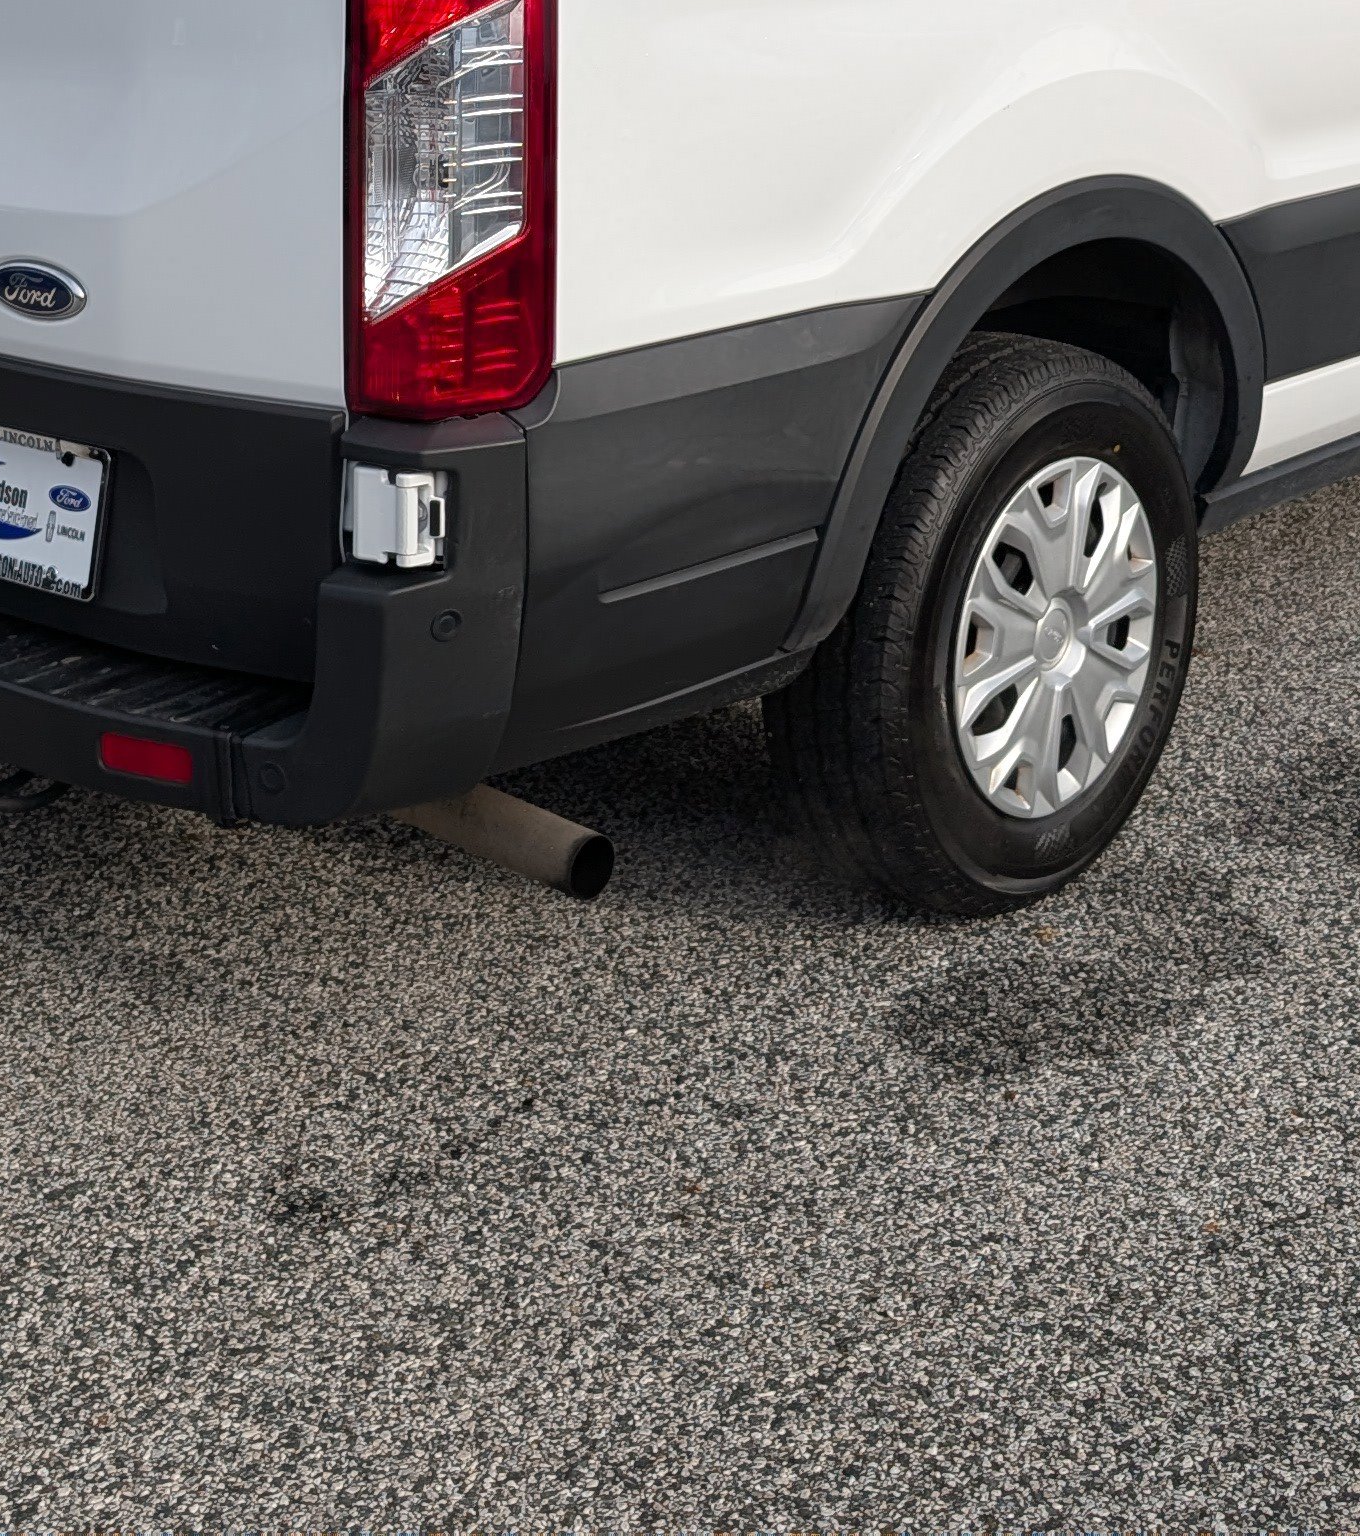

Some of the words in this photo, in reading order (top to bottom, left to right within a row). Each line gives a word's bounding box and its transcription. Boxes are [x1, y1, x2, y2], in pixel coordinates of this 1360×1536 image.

[3, 272, 57, 307] Ford
[54, 488, 85, 509] Ford
[56, 524, 86, 542] LINCOLN
